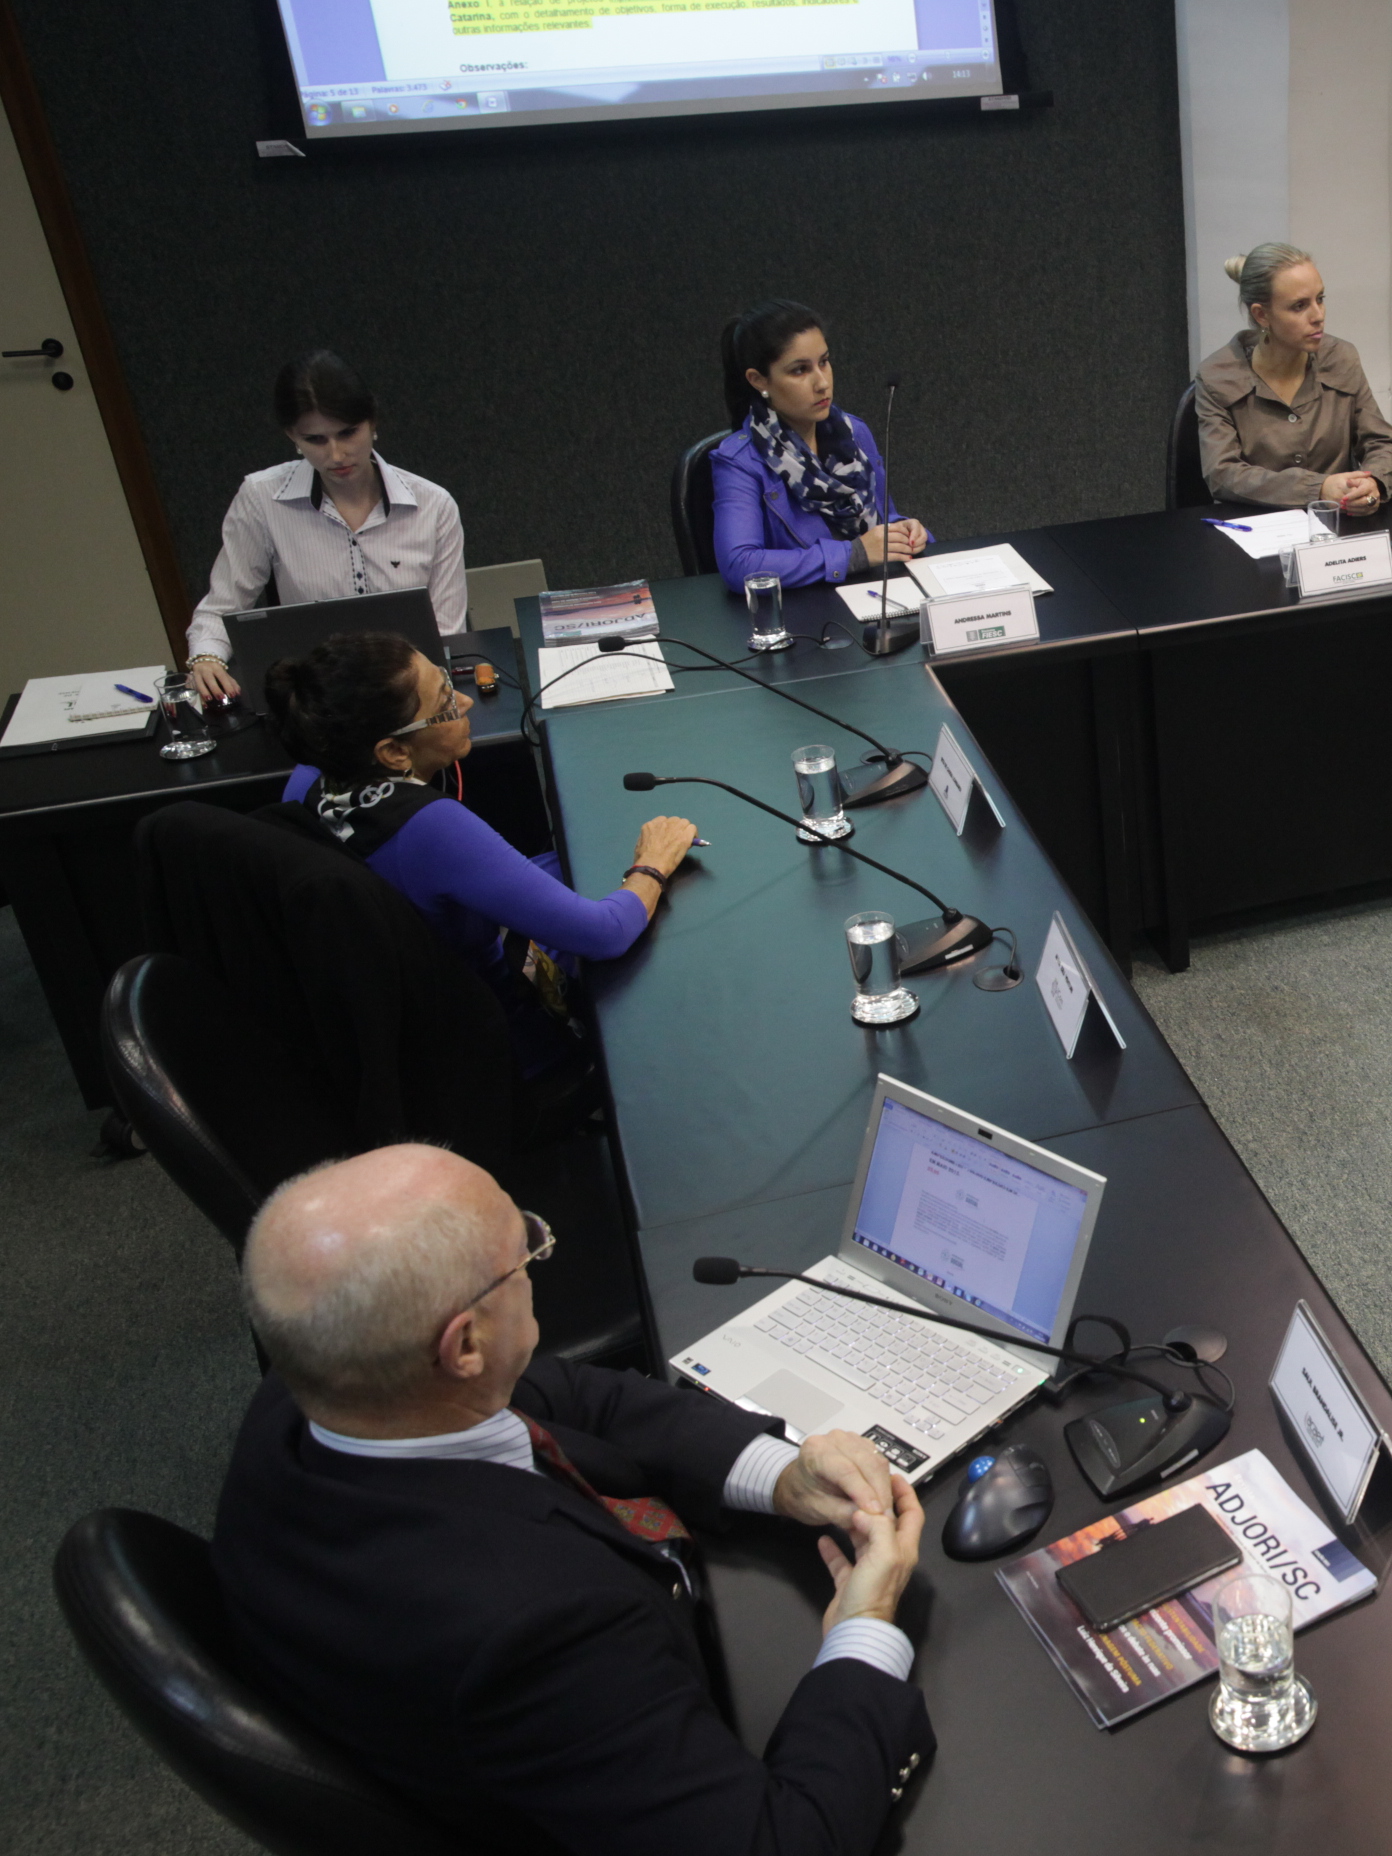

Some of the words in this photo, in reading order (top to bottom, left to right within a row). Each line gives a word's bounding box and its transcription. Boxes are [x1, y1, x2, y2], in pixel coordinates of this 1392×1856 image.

[500, 12, 519, 20] com
[534, 8, 595, 19] detalhamento
[599, 7, 610, 16] de
[662, 3, 687, 12] forma
[453, 25, 481, 35] outras
[484, 21, 540, 33] informações
[459, 61, 528, 73] Observações:
[952, 70, 971, 79] 14:13
[338, 88, 347, 96] de
[1324, 559, 1347, 567] ADELITA
[554, 612, 647, 632] ADJORI/SC
[954, 614, 985, 624] ANDRESSA
[985, 610, 1012, 619] MARTINS
[981, 630, 1003, 639] FIESC
[1205, 1482, 1321, 1601] ADJORI/SC
[1127, 1635, 1146, 1657] debate
[1076, 1624, 1091, 1640] Luiz
[1086, 1636, 1108, 1664] Henrique
[1109, 1668, 1130, 1694] Silveira
[1117, 1655, 1143, 1687] PÓSTUMA
